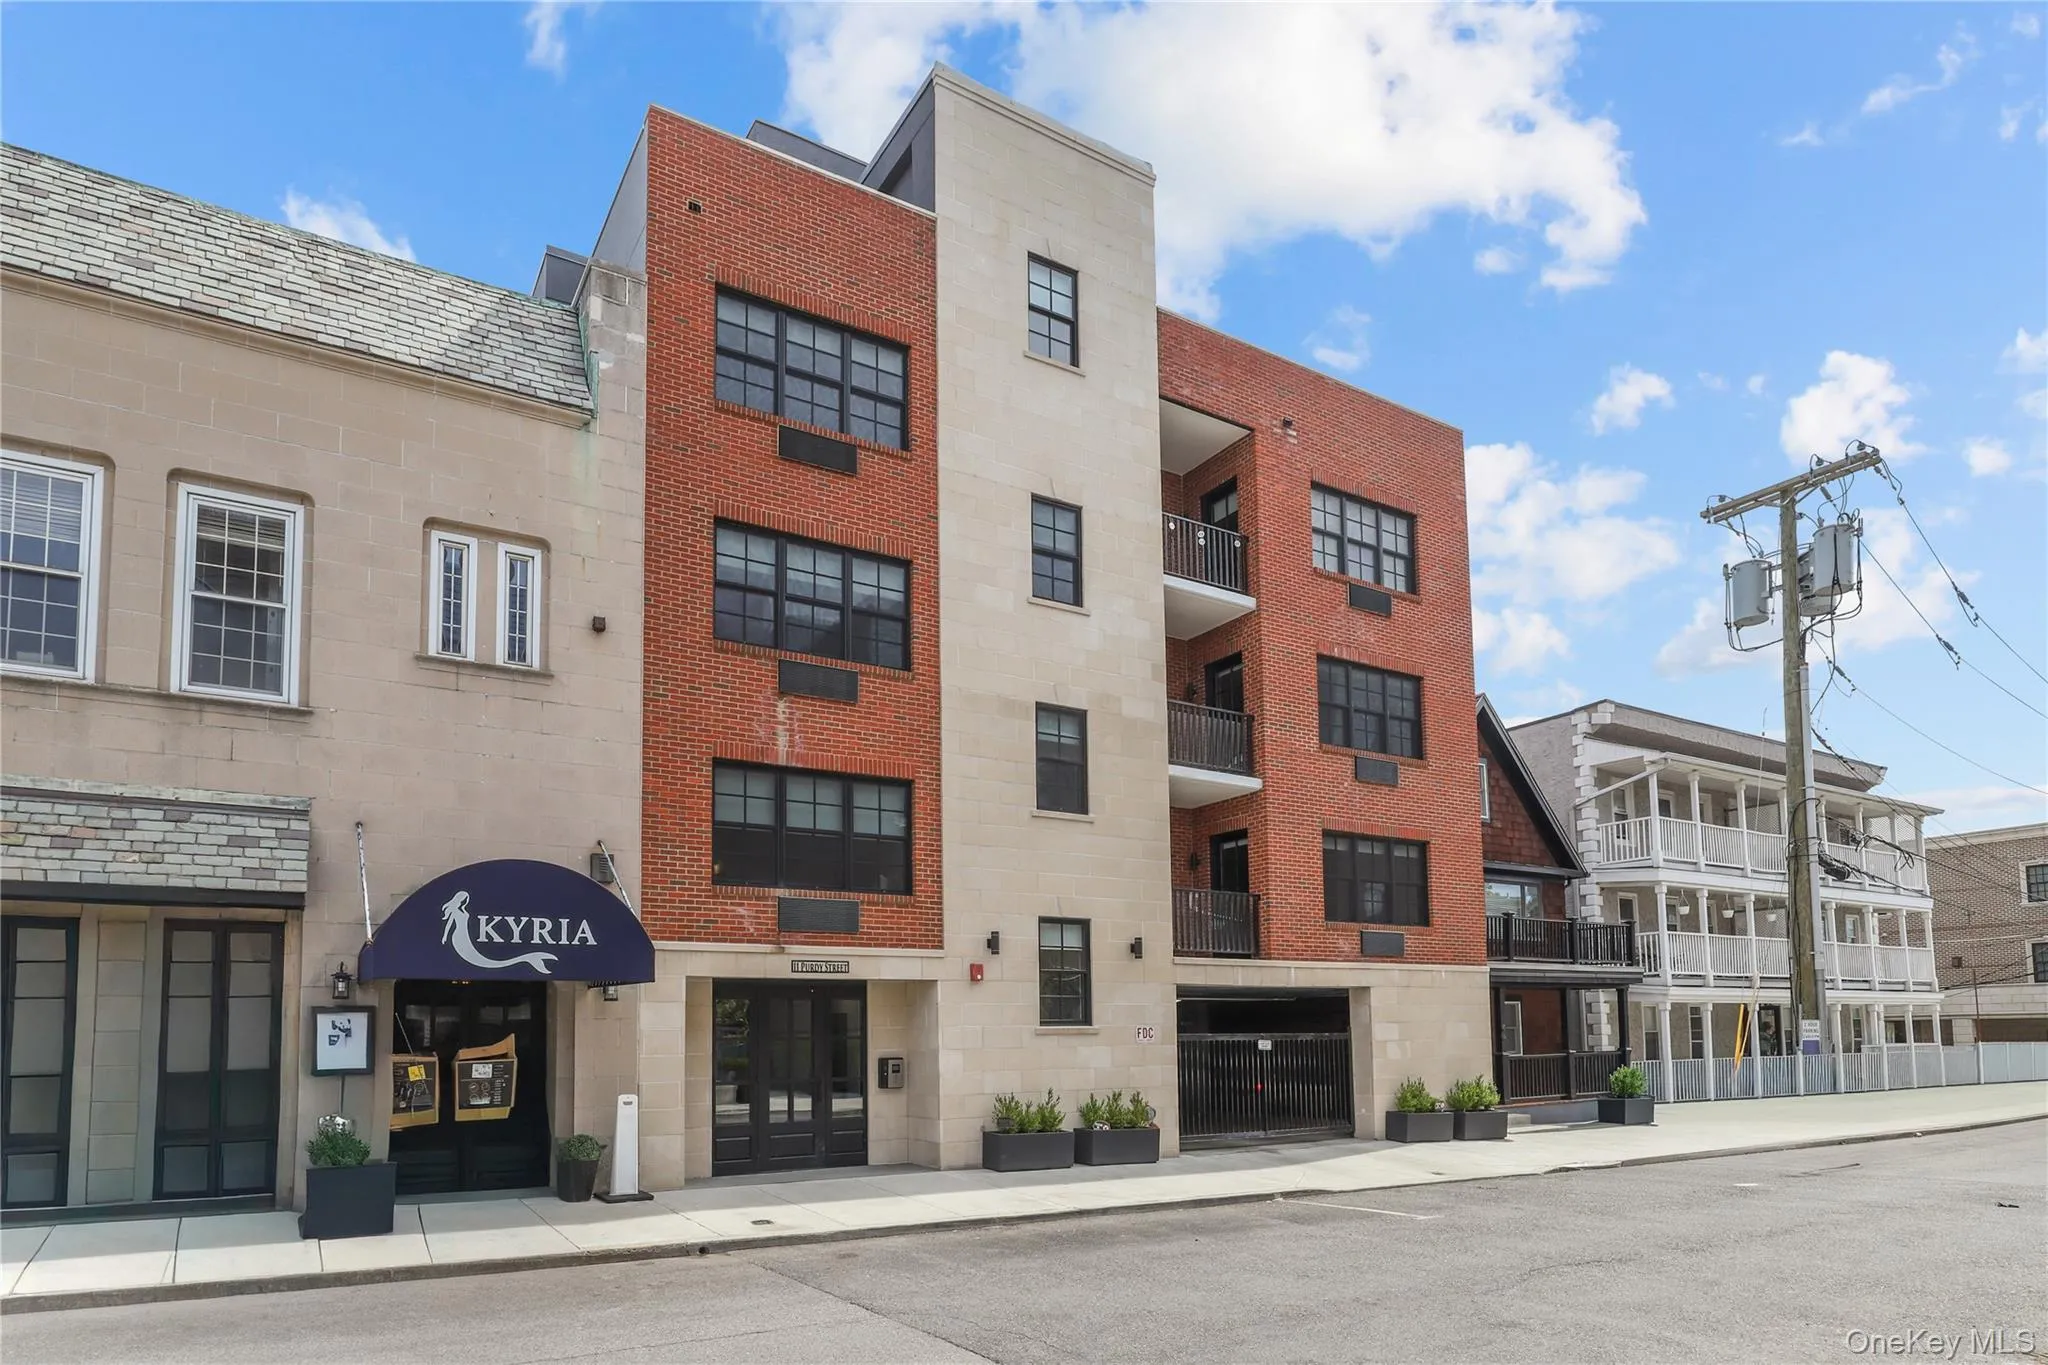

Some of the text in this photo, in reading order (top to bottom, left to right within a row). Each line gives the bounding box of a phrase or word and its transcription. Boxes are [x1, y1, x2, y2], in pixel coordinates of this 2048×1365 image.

[477, 915, 597, 945] KYRIA
[801, 963, 823, 971] PURDY
[825, 962, 848, 971] STREET
[1137, 1027, 1154, 1039] FDC
